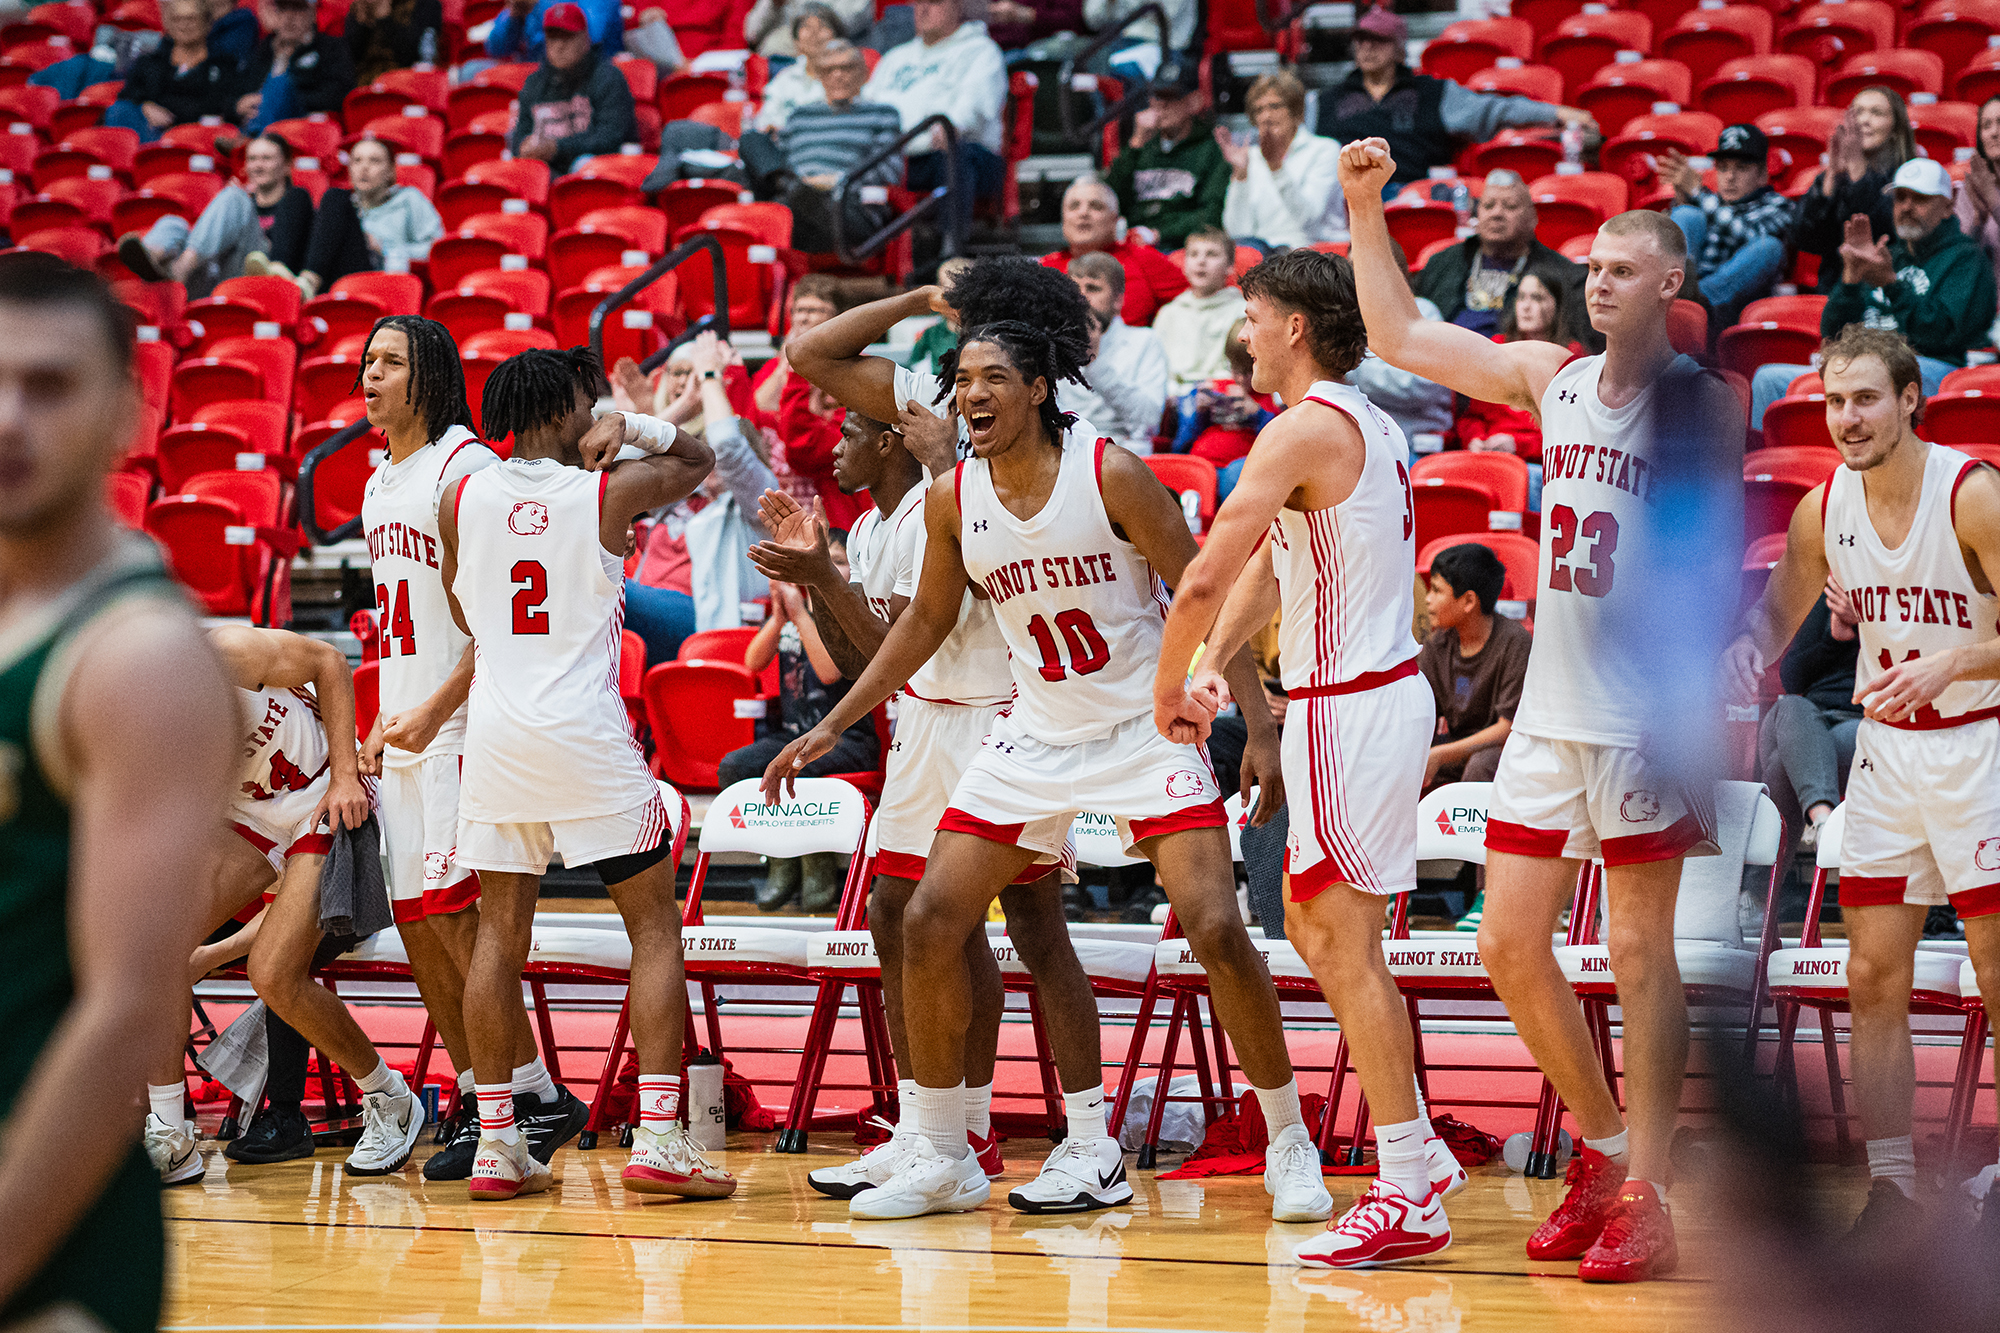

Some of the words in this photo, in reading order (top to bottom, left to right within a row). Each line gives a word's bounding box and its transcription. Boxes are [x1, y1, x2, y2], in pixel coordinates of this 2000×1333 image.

[389, 522, 439, 570] STATE
[1549, 503, 1620, 598] 23
[983, 559, 1038, 606] MINOT
[1042, 552, 1117, 589] STATE
[510, 560, 549, 635] 2
[1846, 586, 1891, 623] NOT
[1896, 586, 1973, 629] STATE
[376, 579, 416, 659] 24
[1027, 608, 1111, 682] 10
[743, 802, 841, 817] PINNACLE
[748, 819, 795, 828] EMPLOYEE
[796, 817, 835, 828] BENEFITS
[699, 938, 737, 951] STATE
[825, 942, 868, 956] MINOT
[1388, 951, 1435, 966] MINOT
[1440, 951, 1482, 966] STATE
[1580, 957, 1611, 972] MIN
[1792, 960, 1841, 975] MINOT
